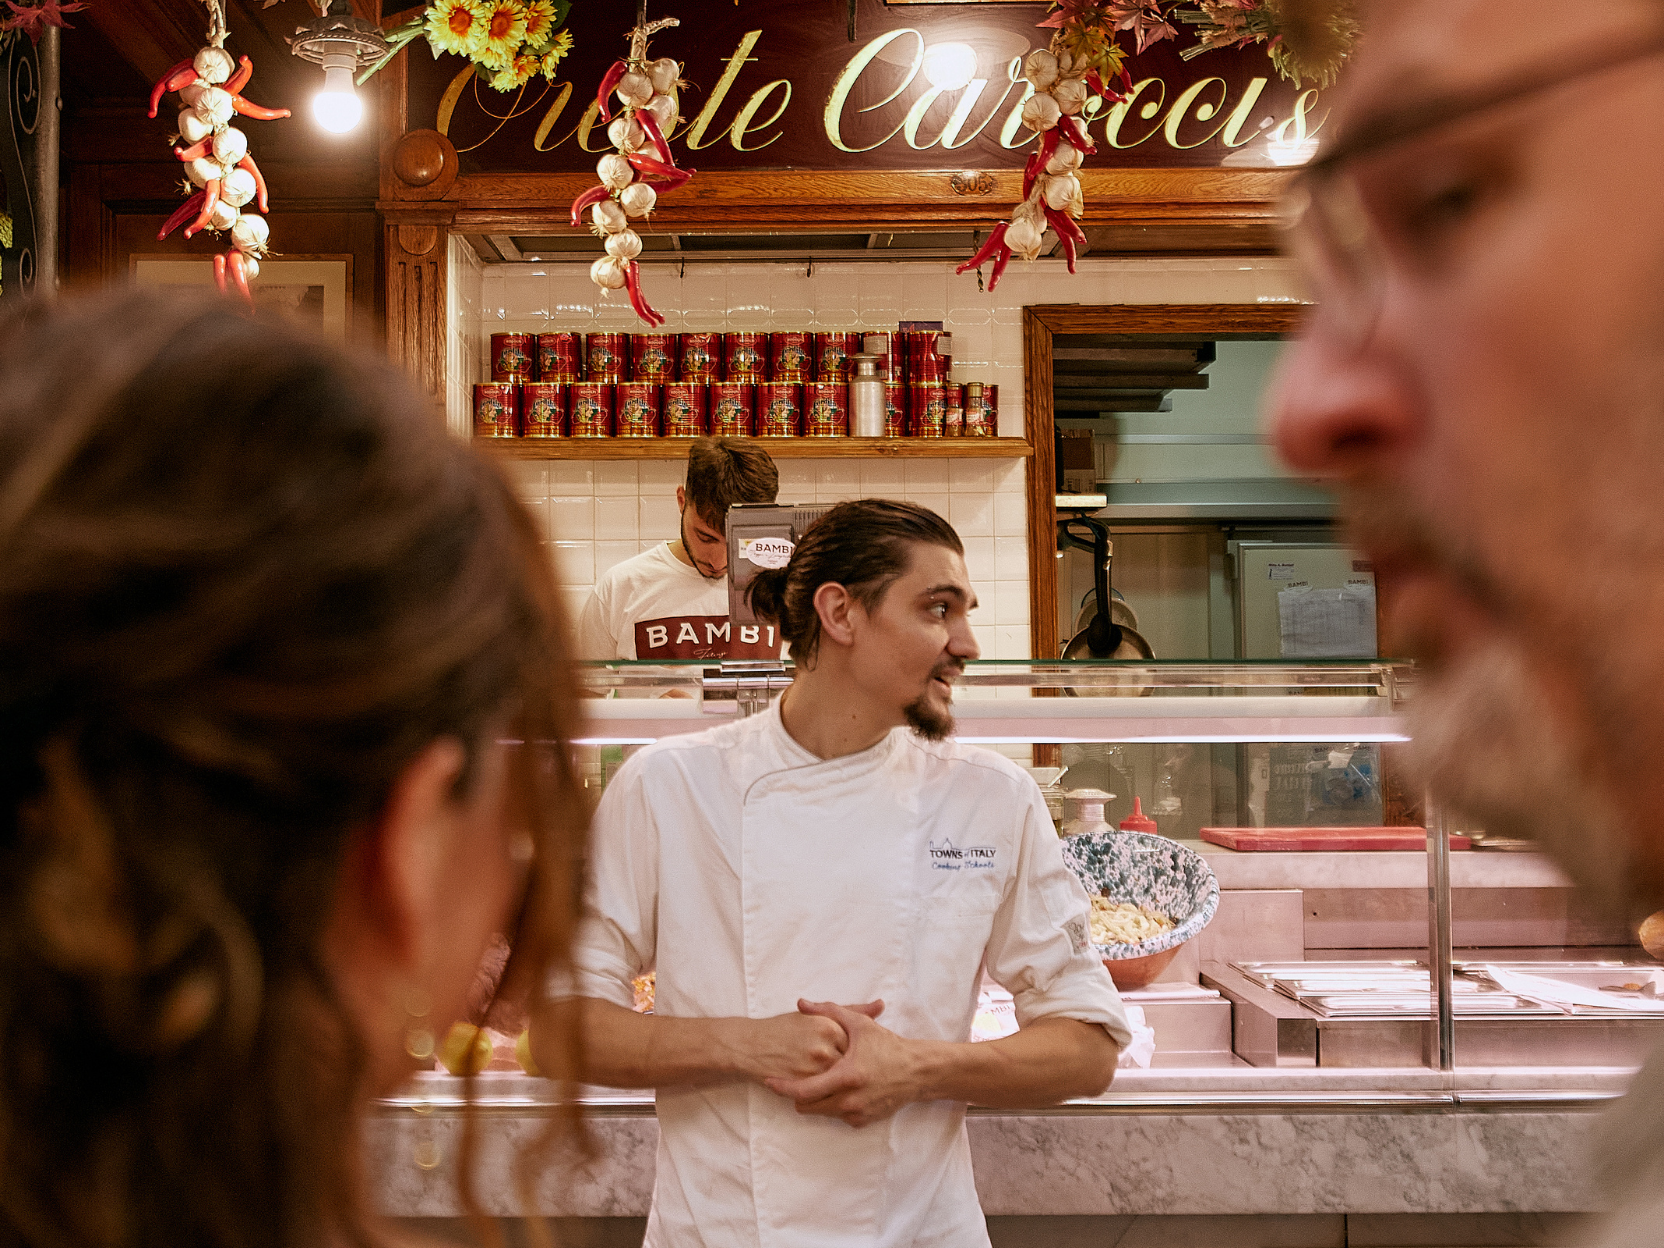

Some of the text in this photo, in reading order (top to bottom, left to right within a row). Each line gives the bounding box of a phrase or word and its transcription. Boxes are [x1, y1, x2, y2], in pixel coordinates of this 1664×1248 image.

[437, 29, 792, 153] Orete
[824, 27, 1268, 153] Carcci
[646, 622, 775, 649] BAMBI
[929, 849, 963, 859] TOWNS
[970, 849, 996, 858] ITALY
